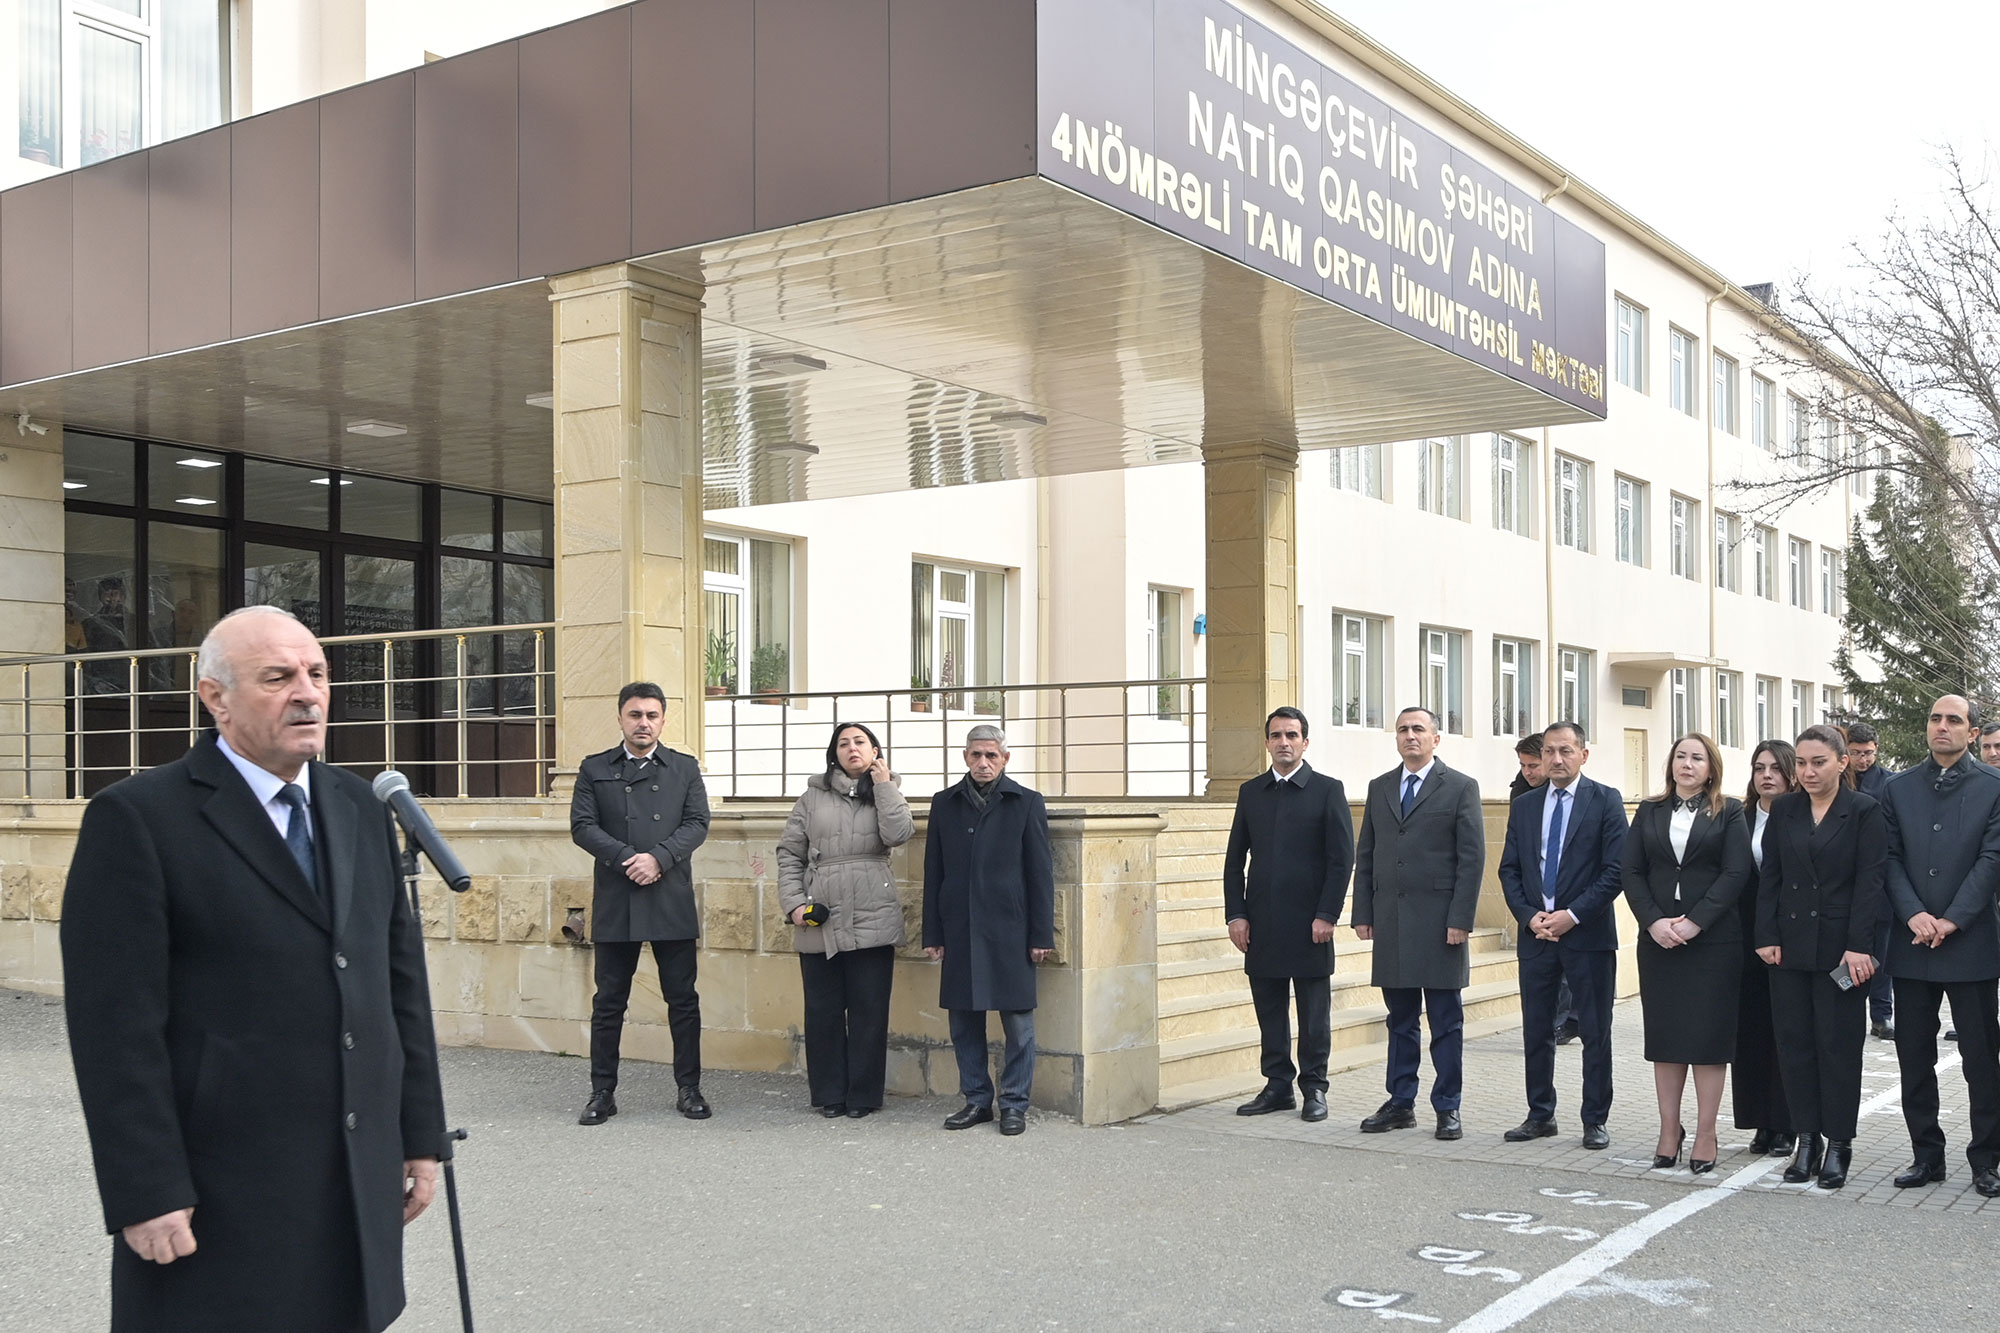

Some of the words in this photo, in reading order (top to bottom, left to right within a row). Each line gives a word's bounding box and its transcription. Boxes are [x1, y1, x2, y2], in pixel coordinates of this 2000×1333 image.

[1188, 90, 1305, 206] NATİQ
[1319, 165, 1455, 275] QASIMOV
[1468, 246, 1543, 321] ADINA
[1204, 16, 1419, 190] MİNGƏÇEVİR
[1440, 163, 1534, 255] ŞƏHƏRİ
[1242, 200, 1302, 268] TAM
[1313, 236, 1383, 305] ORTA
[1391, 263, 1524, 366] ÜMUMTƏHSİL
